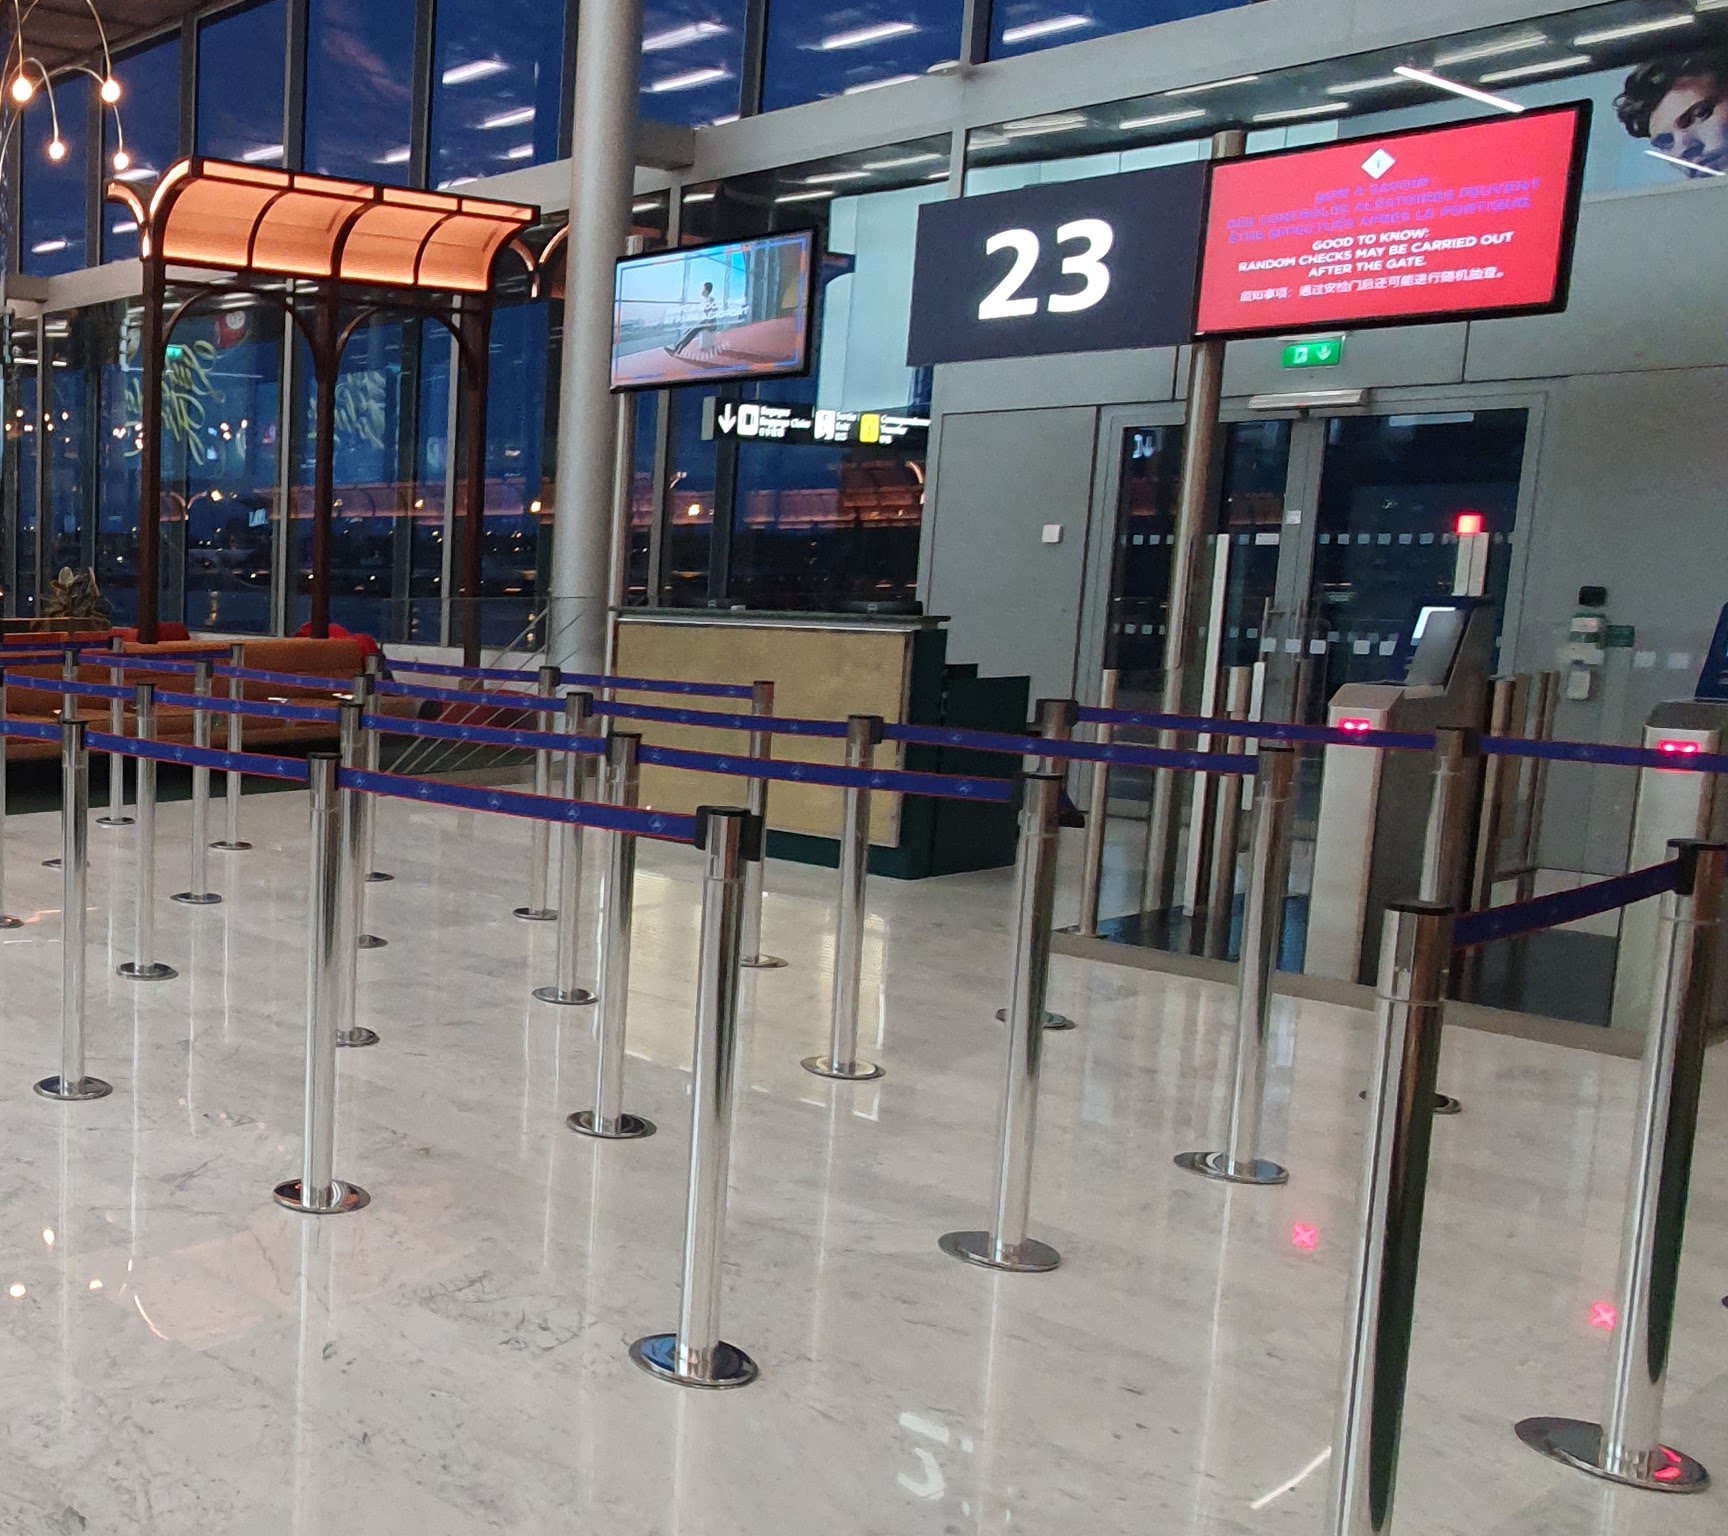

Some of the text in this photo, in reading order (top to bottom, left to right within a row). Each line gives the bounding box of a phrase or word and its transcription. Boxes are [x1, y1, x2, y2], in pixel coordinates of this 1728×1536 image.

[1239, 231, 1514, 271] RANDOM CHECKS MAY BE CARRIED OUT
[1312, 228, 1429, 250] GOOD TO KNOW:
[978, 218, 1115, 320] 23
[1309, 264, 1351, 277] AFTER
[1355, 260, 1382, 271] THE
